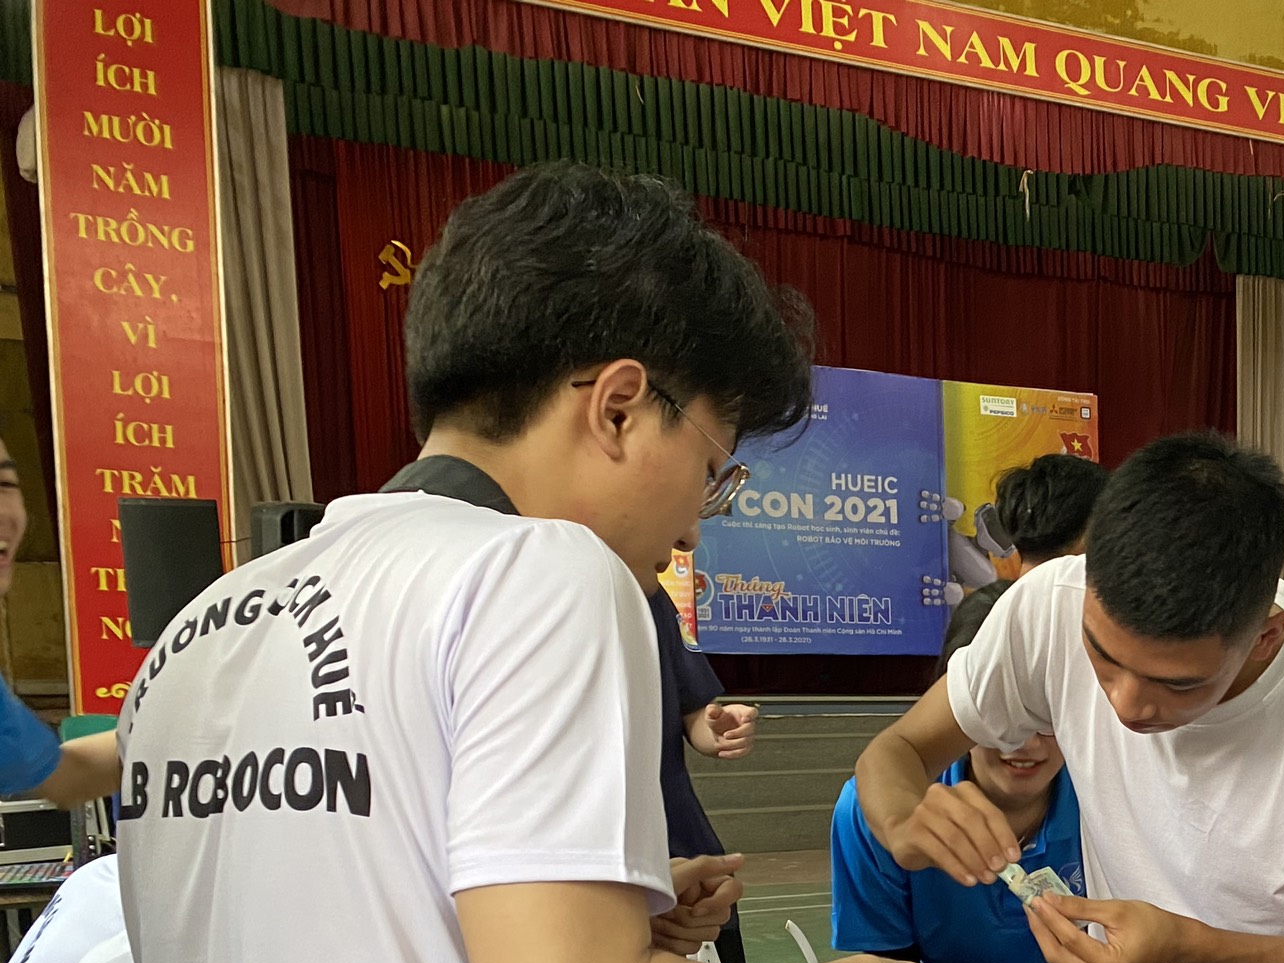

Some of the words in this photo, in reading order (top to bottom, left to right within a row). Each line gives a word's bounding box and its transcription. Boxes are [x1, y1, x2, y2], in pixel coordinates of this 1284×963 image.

[93, 9, 154, 46] LỢI
[96, 53, 157, 95] ÍCH
[915, 19, 1039, 77] NAM
[1055, 50, 1229, 113] QUANG
[83, 111, 173, 149] MƯỜI
[91, 162, 171, 199] NĂM
[70, 208, 195, 252] TRỒNG
[120, 316, 157, 348] VÌ
[112, 370, 172, 403] LỢI
[114, 413, 174, 448] ÍCH
[96, 466, 198, 498] TRĂM
[831, 472, 898, 494] HUEIC
[738, 490, 814, 519] CON
[824, 495, 898, 524] 2021
[797, 535, 823, 543] ROBOT
[715, 574, 791, 602] Tháng
[717, 593, 820, 623] THANH
[827, 593, 891, 624] NIÊN
[161, 747, 371, 818] ROBOCON
